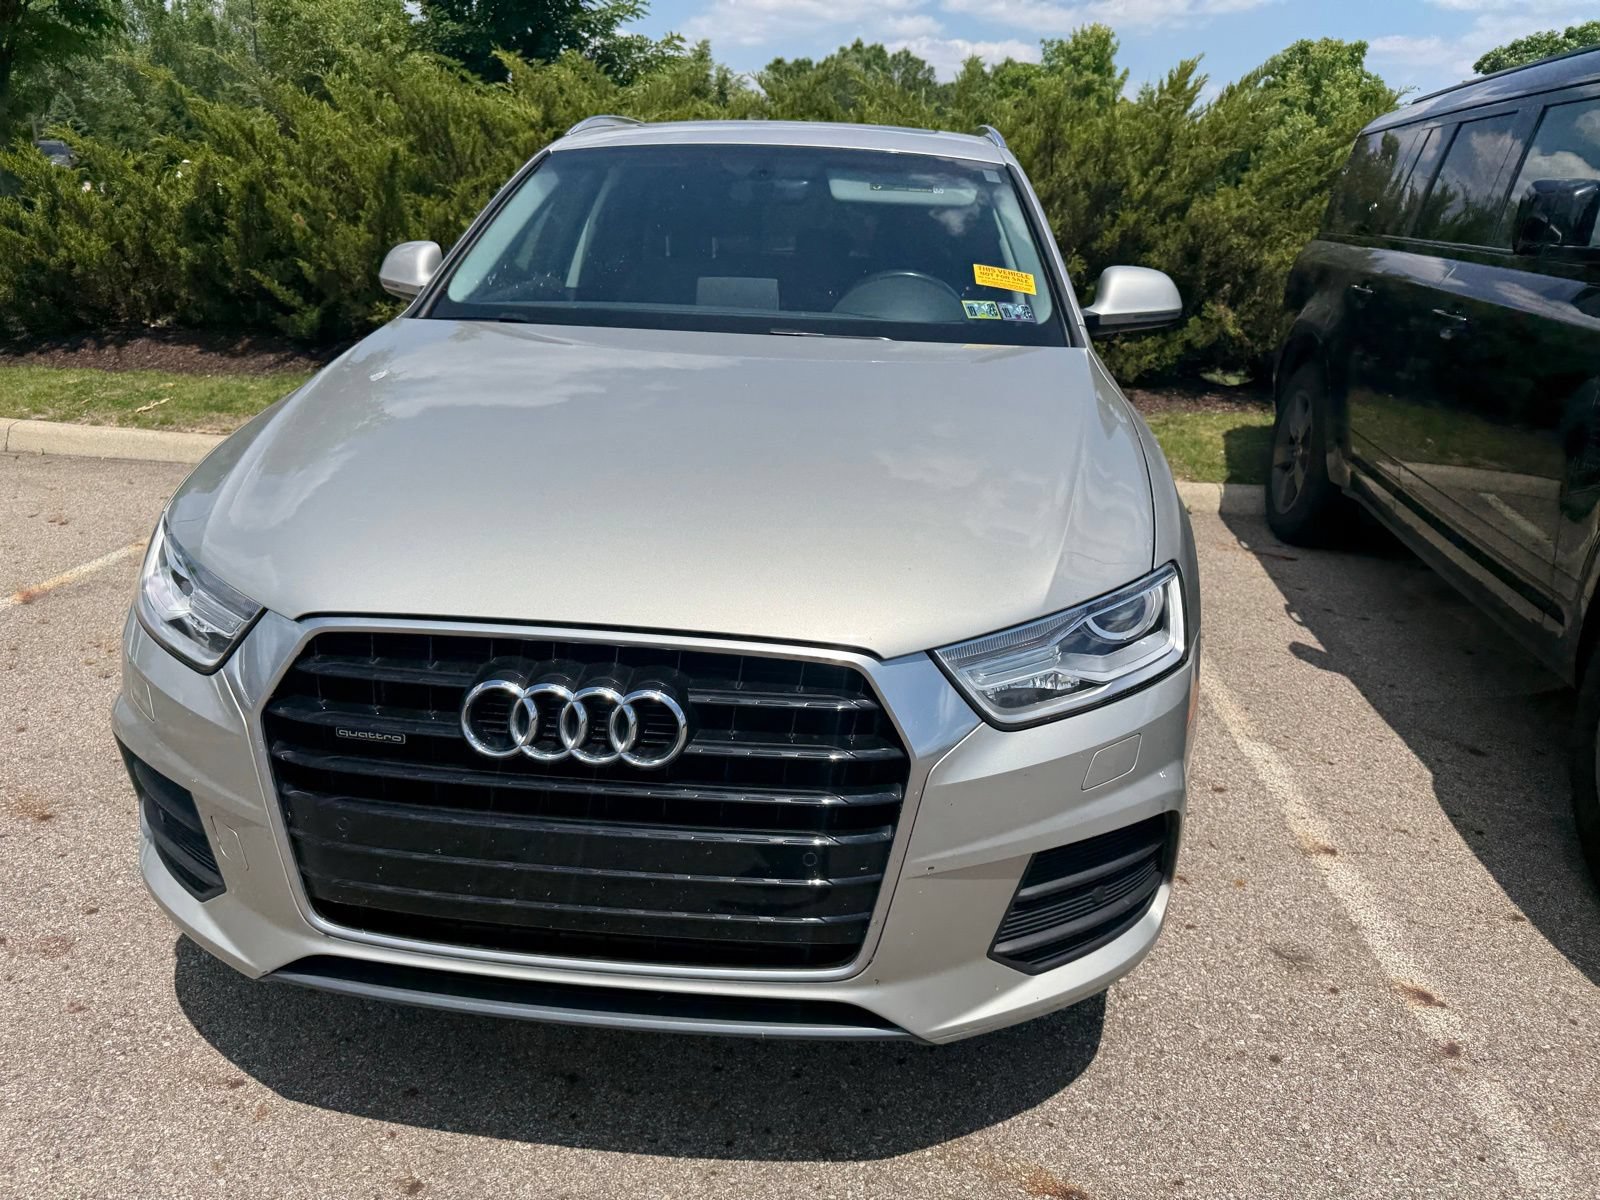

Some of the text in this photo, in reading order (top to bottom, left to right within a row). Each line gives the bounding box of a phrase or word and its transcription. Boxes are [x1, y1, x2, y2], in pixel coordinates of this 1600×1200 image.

[978, 265, 1031, 280] THIS VEHICLE
[338, 729, 402, 742] quattro
